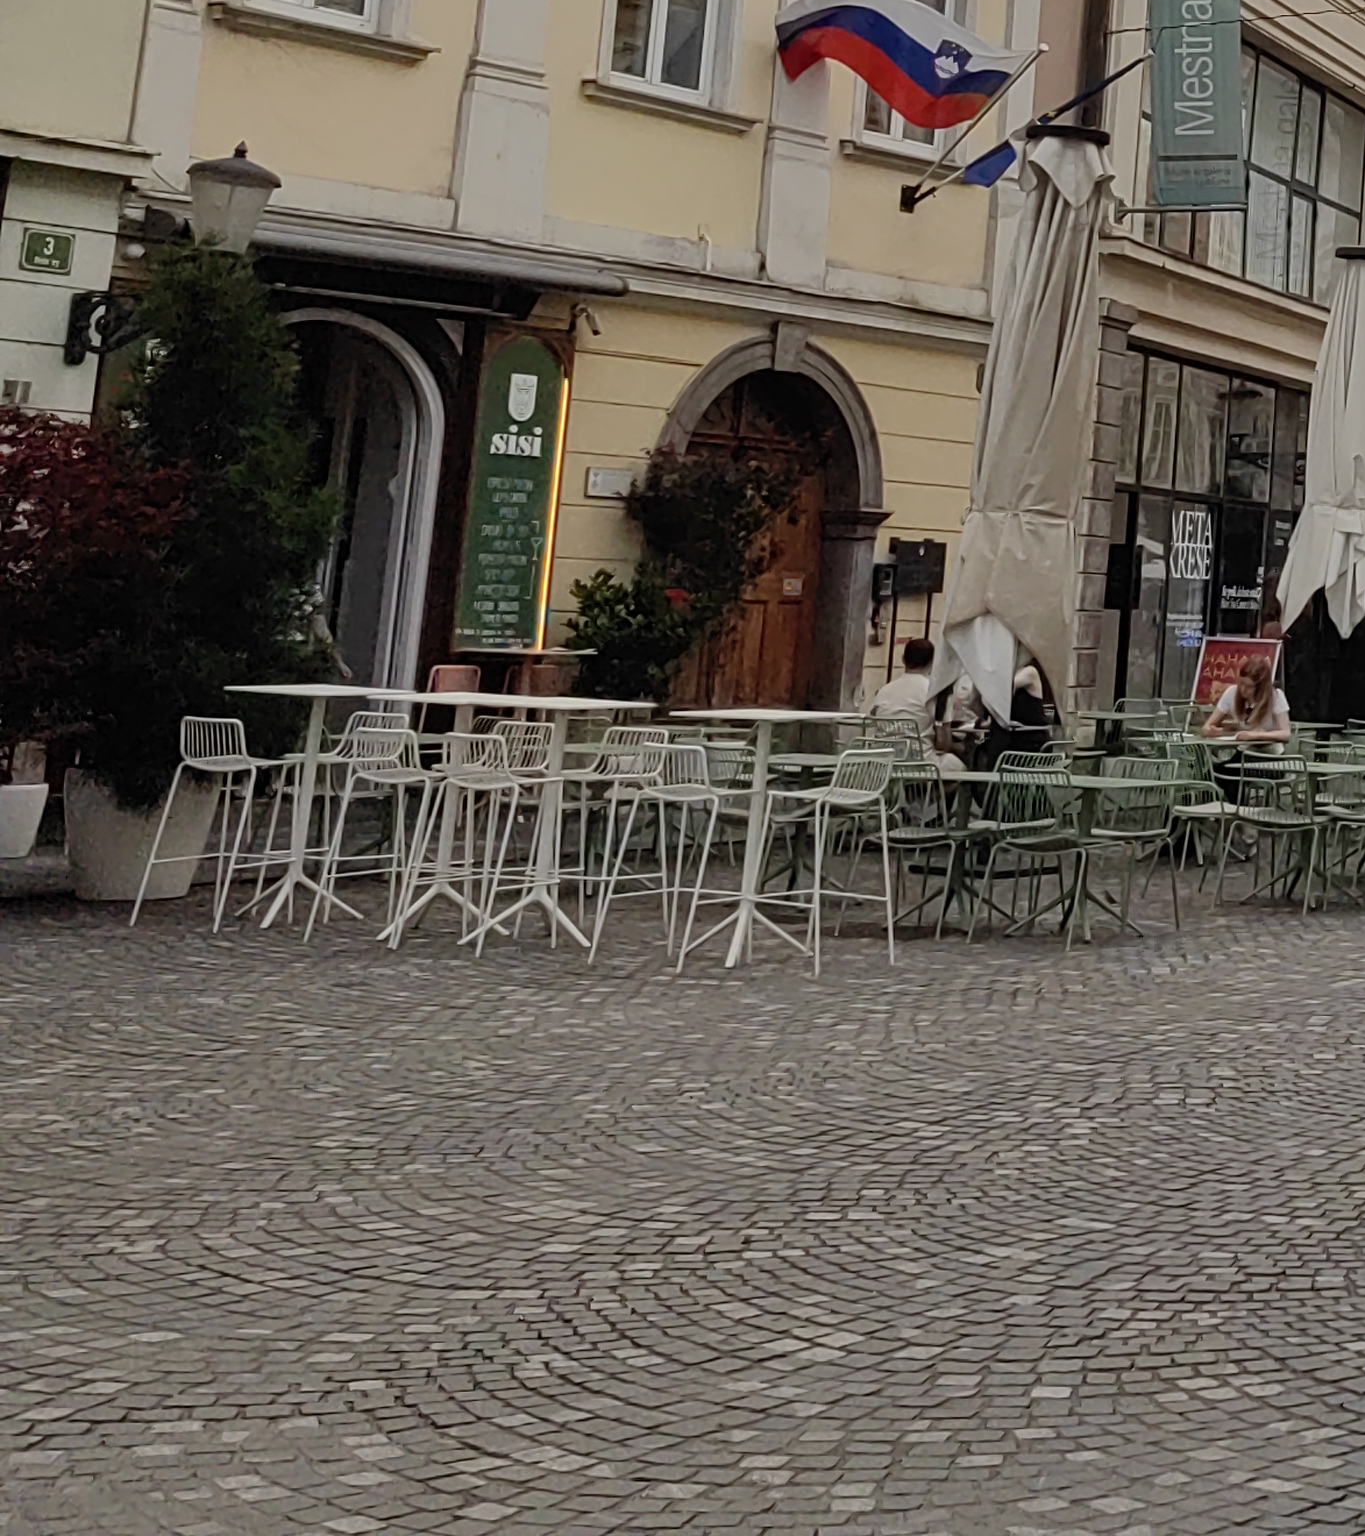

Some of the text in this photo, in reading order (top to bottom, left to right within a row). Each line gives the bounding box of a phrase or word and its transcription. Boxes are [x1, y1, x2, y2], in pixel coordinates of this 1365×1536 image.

[43, 236, 55, 256] 3
[489, 424, 543, 458] sisi
[1171, 510, 1213, 546] META
